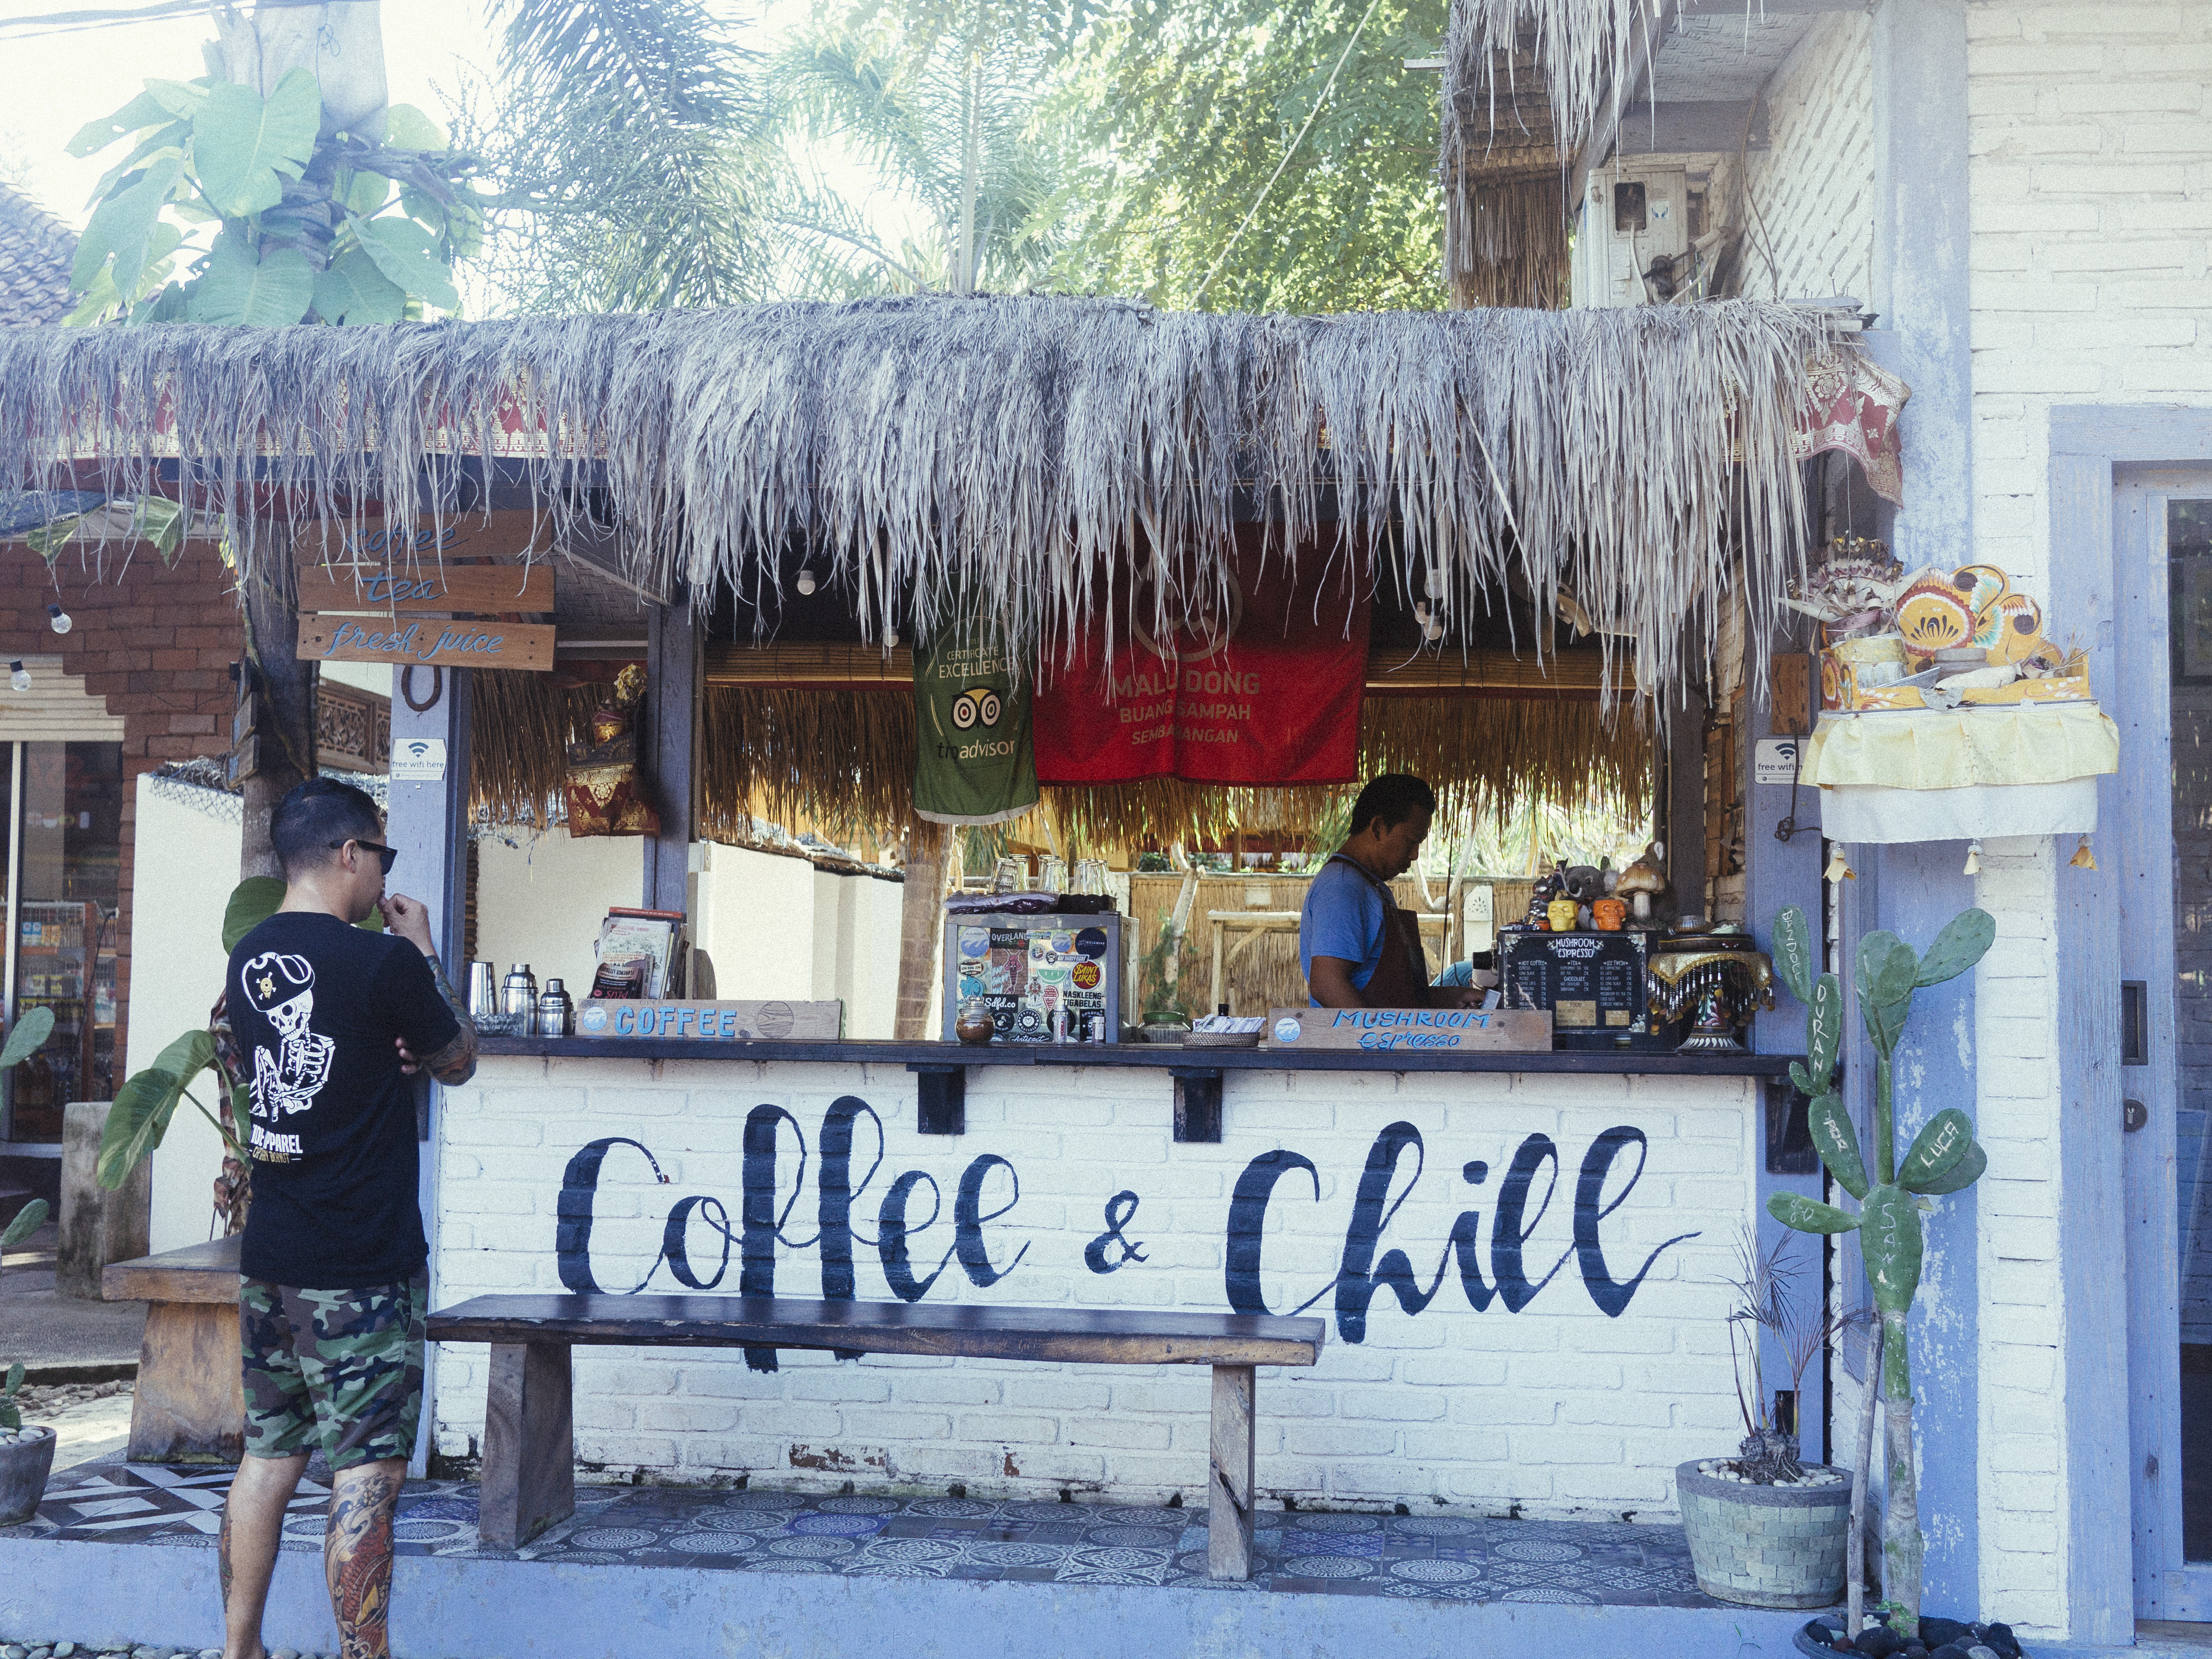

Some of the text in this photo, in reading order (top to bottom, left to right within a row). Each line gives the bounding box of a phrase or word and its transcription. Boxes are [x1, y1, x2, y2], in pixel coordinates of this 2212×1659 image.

[362, 571, 445, 602] tea
[324, 622, 504, 660] fresh juice
[947, 646, 999, 661] CERTFICATE
[1110, 670, 1260, 698] MALU DONG
[1120, 699, 1250, 723] BUANG SAMPAH
[1131, 723, 1238, 745] SEMBARANGAN
[1555, 938, 1595, 949] MUSHROOM
[1558, 948, 1594, 958] ESPRESSO
[1073, 974, 1097, 986] LUKAS
[985, 997, 1016, 1010] Sdfd.co
[1063, 998, 1101, 1008] TIGABELAS
[614, 1006, 737, 1037] COFFEE
[1333, 1010, 1490, 1029] MUSHROOM
[1357, 1031, 1462, 1050] espresso
[555, 1095, 1703, 1373] Coffee & Chill
